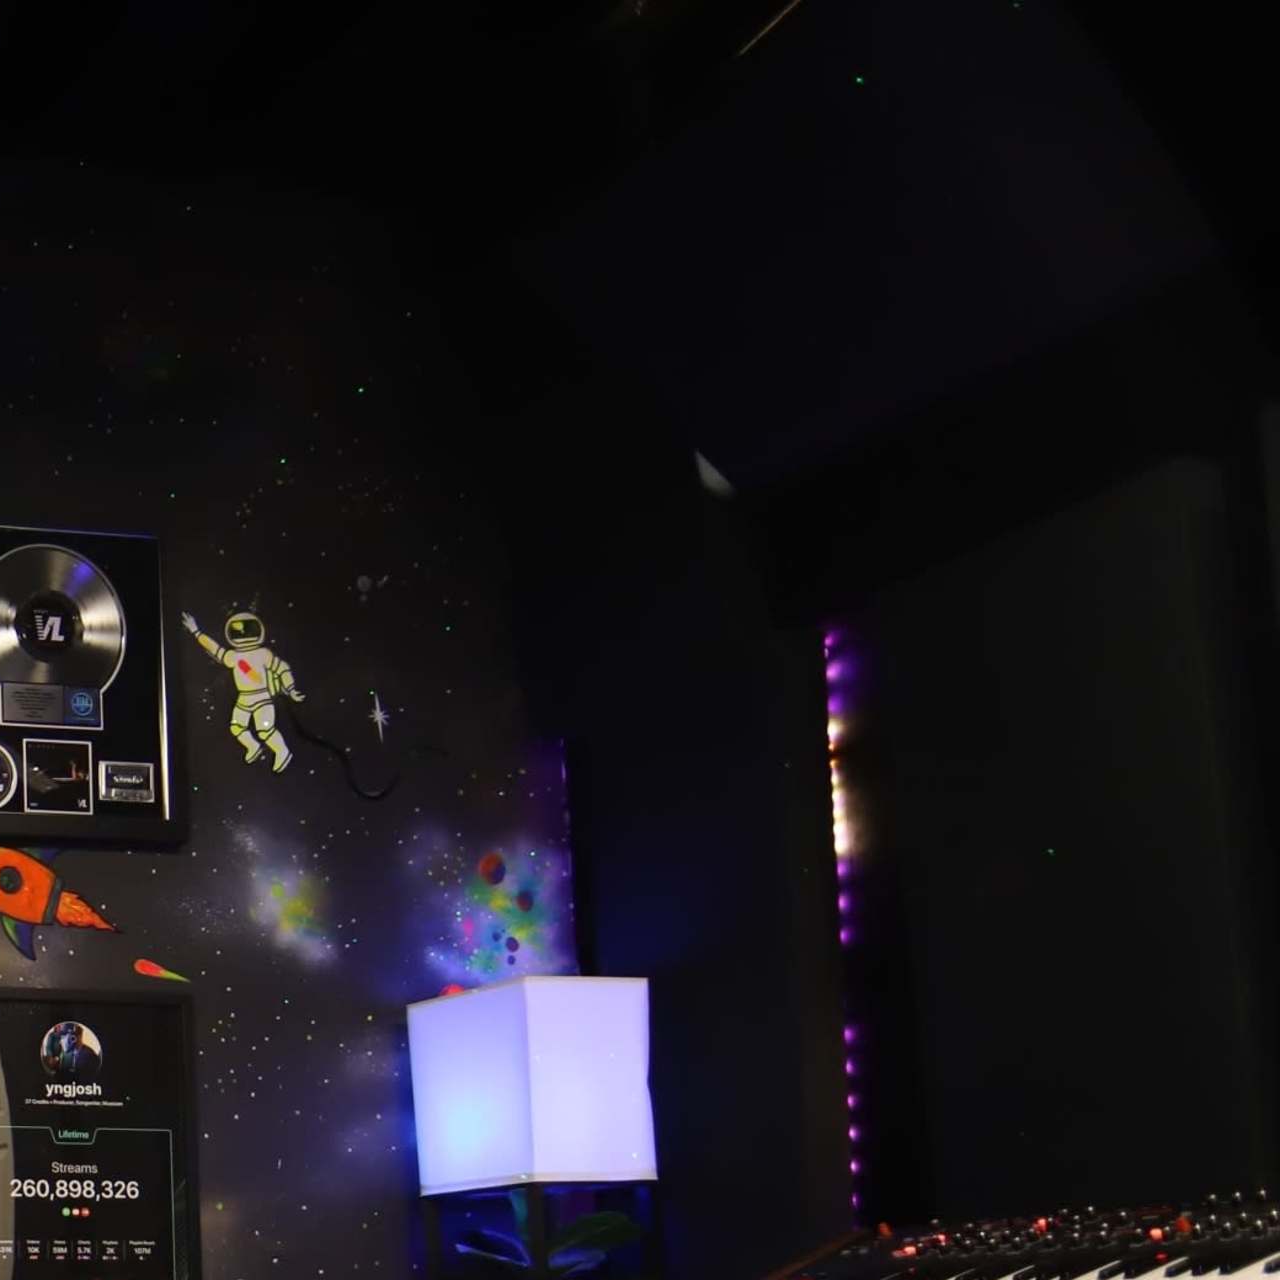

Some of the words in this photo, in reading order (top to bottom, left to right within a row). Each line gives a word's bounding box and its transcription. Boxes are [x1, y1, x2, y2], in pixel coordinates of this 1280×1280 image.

[45, 1082, 102, 1098] yngjosh
[58, 1129, 89, 1139] Lifetime
[51, 1161, 98, 1174] Streams
[10, 1179, 140, 1201] 260,898,326
